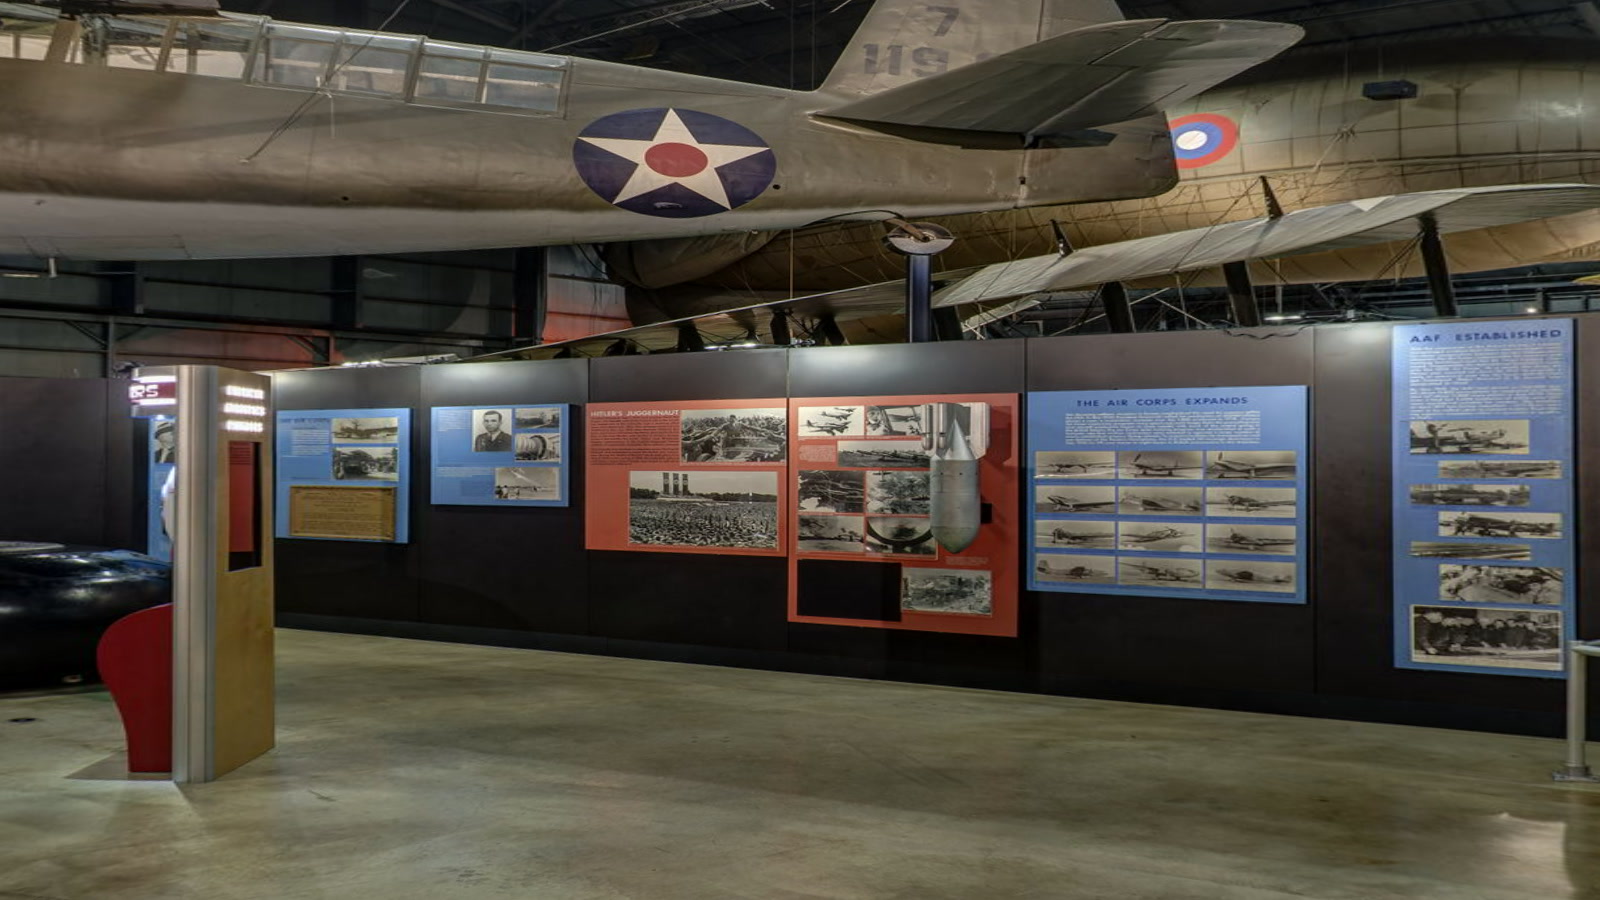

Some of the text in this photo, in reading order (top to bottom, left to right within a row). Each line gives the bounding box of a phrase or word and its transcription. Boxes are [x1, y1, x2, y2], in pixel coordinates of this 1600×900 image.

[926, 5, 960, 37] 7
[862, 43, 997, 77] 119
[1409, 329, 1562, 343] AAF ESTABLISHED
[1076, 396, 1249, 407] THE AIR CORPS EXPANDS
[590, 409, 680, 417] HITLER'S JUGGERNAUT
